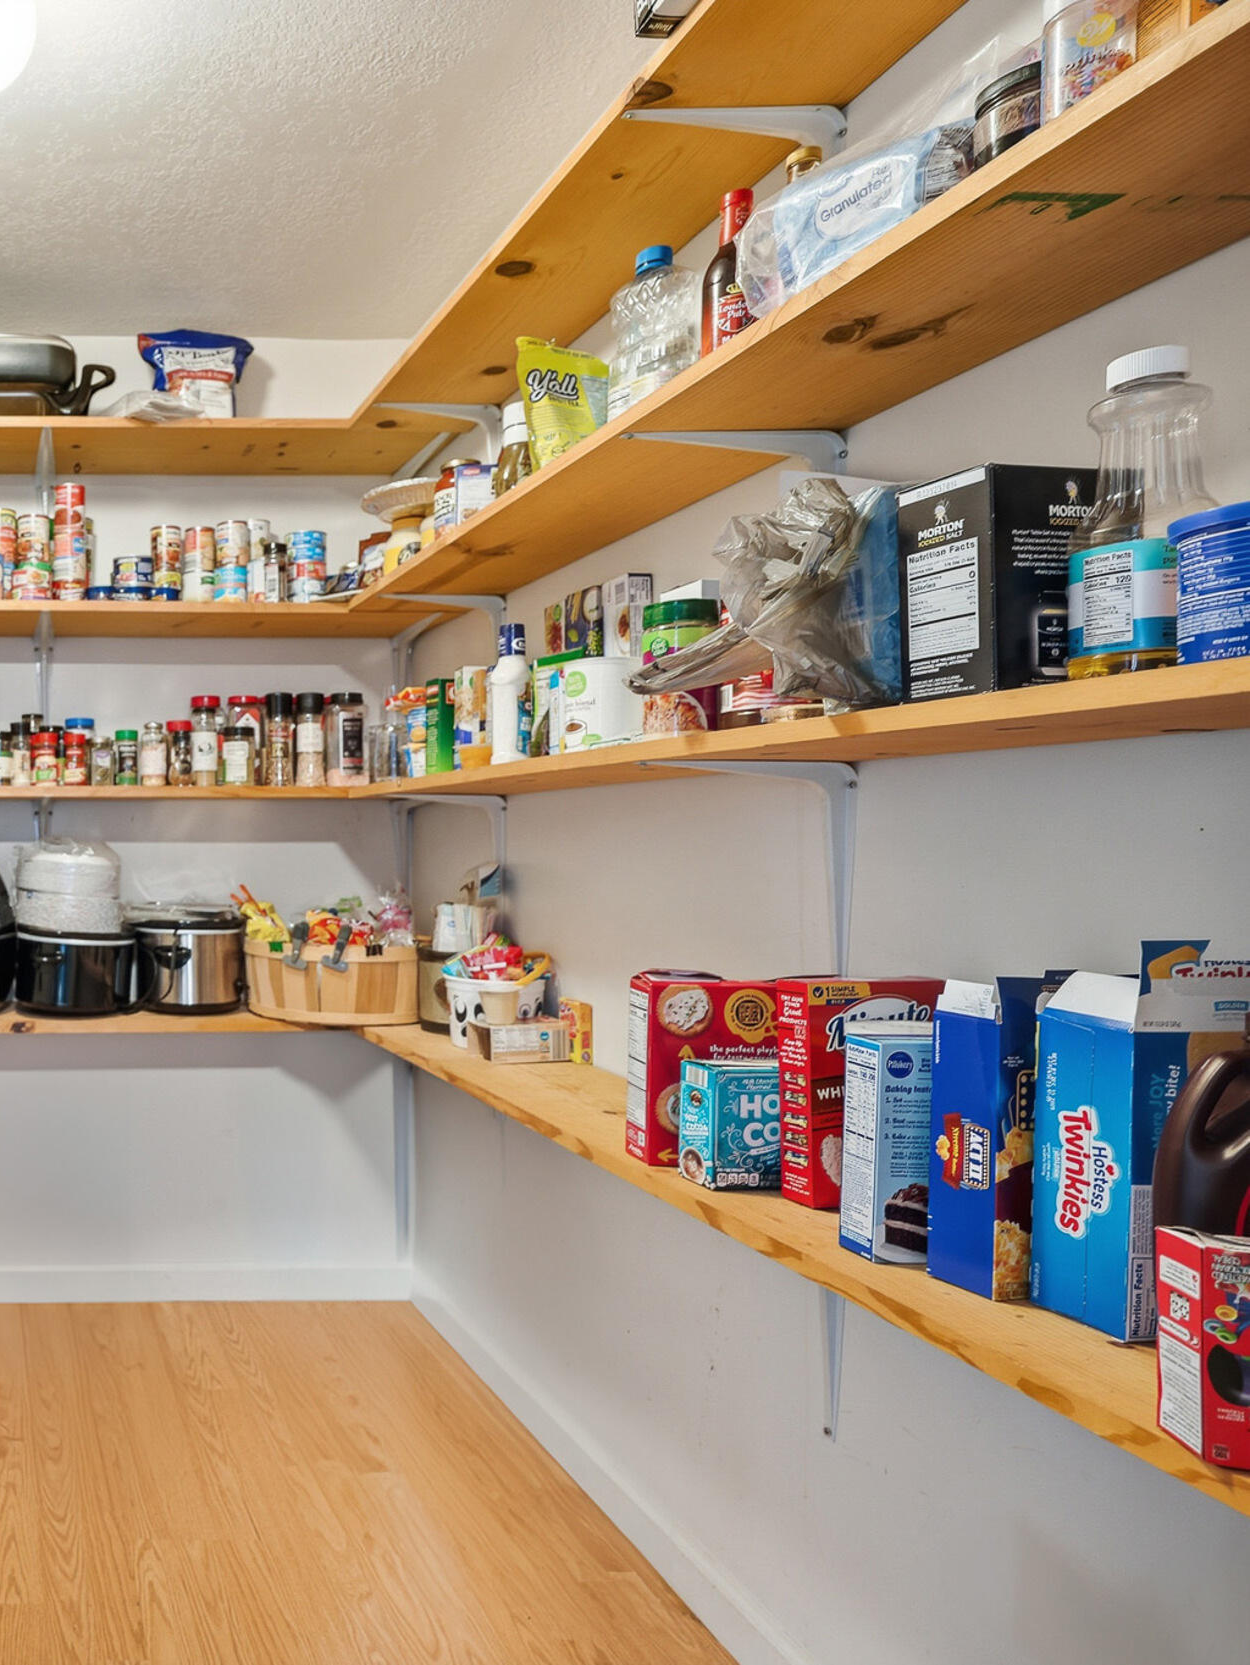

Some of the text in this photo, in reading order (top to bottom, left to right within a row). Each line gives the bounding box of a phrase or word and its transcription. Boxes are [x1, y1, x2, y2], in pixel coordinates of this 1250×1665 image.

[820, 172, 892, 222] Granulated
[717, 300, 749, 312] Londo
[526, 369, 579, 403] Y'all
[918, 518, 965, 541] MORTON
[945, 529, 964, 540] SALT
[909, 541, 975, 563] Nutrition Facts
[1085, 552, 1132, 566] Nutrition Facts
[969, 570, 976, 579] 0
[827, 1002, 930, 1051] Mte
[725, 1045, 754, 1055] perfect
[817, 1086, 845, 1100] WHI
[885, 1085, 912, 1095] Baking
[1149, 1074, 1165, 1107] JOY
[1164, 1064, 1180, 1097] bite!
[740, 1094, 780, 1118] HO
[969, 1131, 983, 1182] ACT II
[1059, 1110, 1092, 1233] Twinkies
[1091, 1146, 1108, 1209] Hostess
[1132, 1263, 1143, 1290] Facts
[1132, 1293, 1142, 1336] Nutrition
